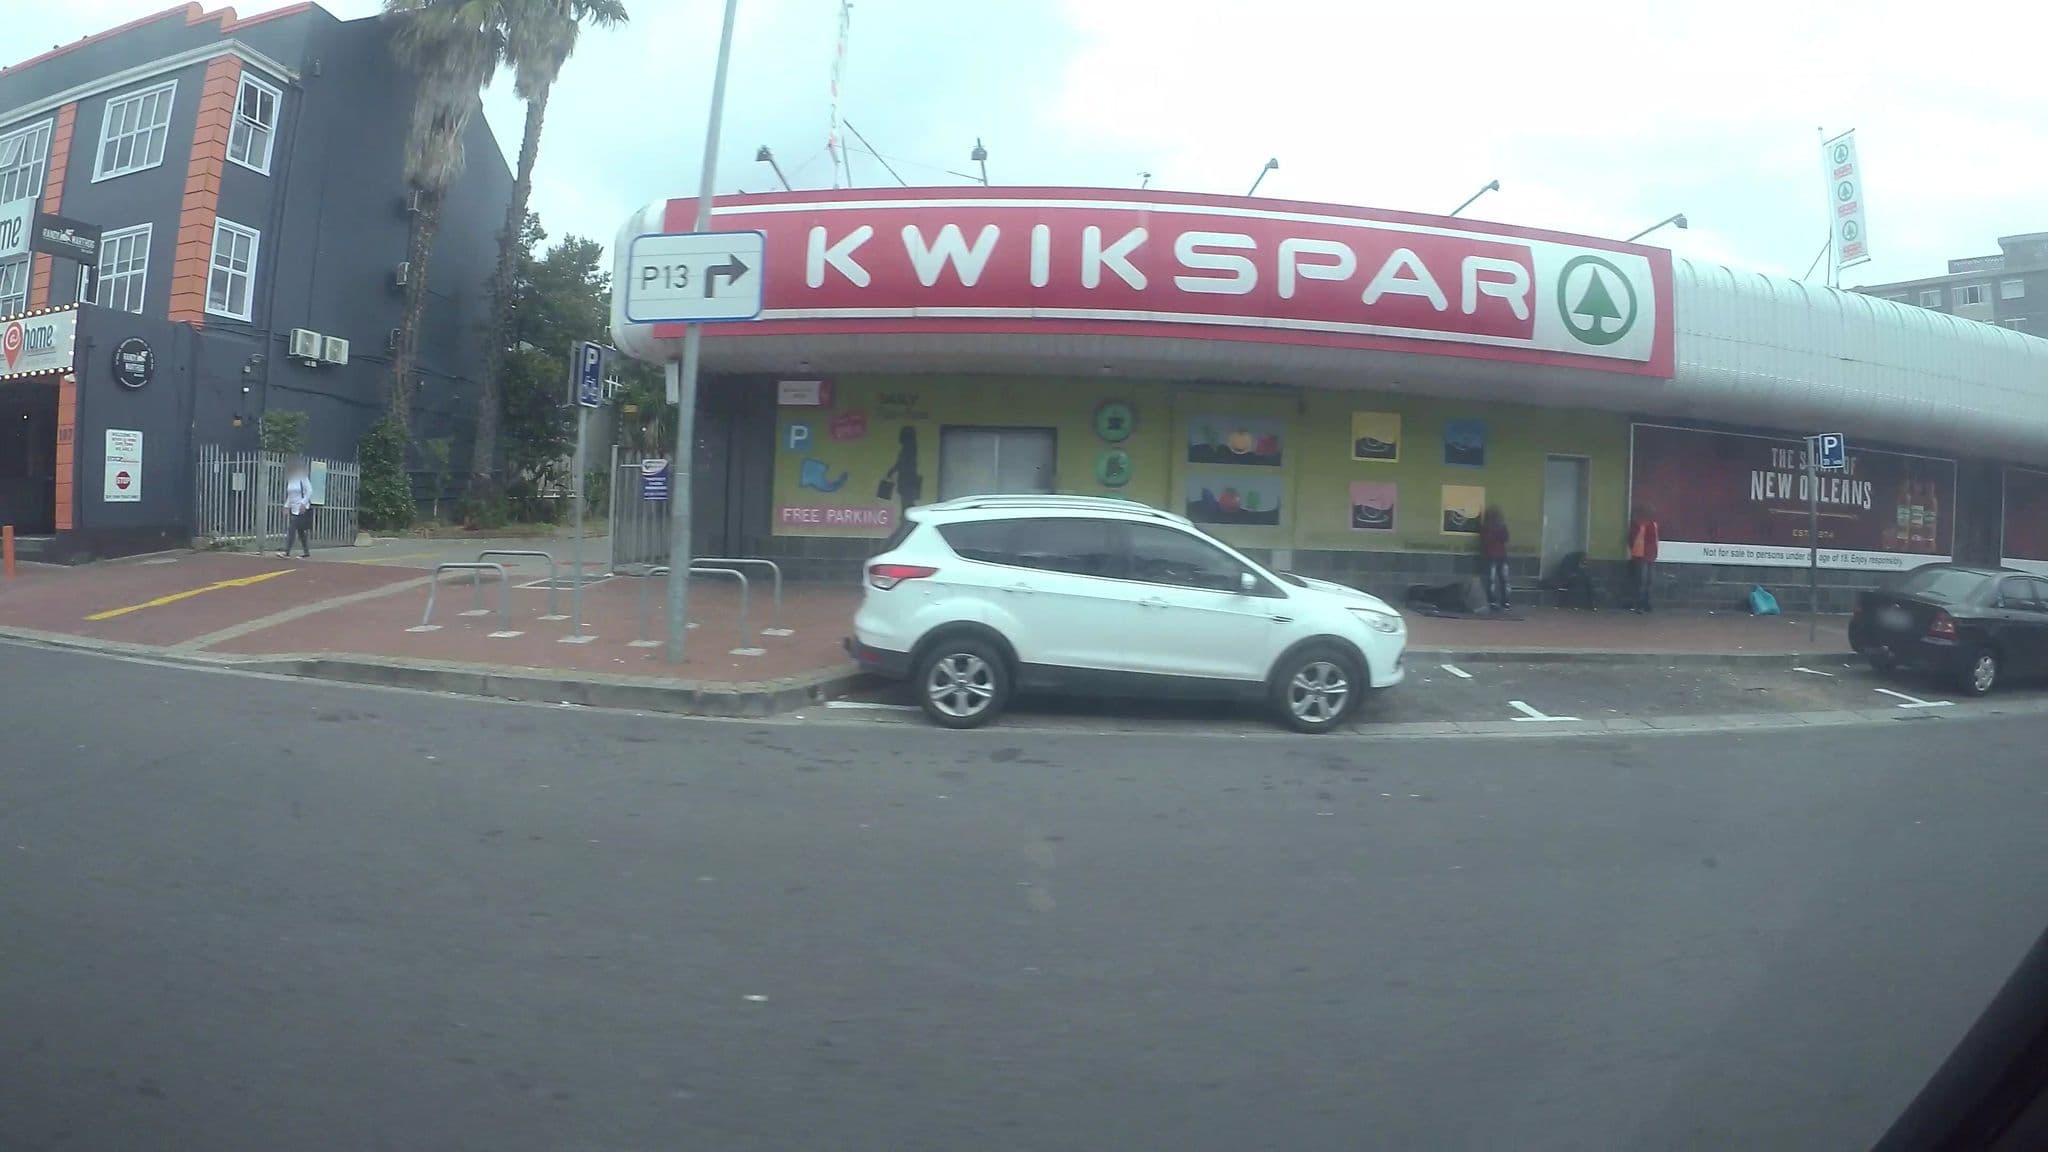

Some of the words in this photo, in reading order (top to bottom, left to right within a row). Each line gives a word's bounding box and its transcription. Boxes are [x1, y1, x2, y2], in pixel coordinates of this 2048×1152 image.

[641, 264, 689, 290] P13
[805, 223, 1531, 320] KWIKSPAR
[585, 347, 599, 372] P
[790, 425, 808, 449] P
[1824, 436, 1838, 455] P
[1772, 448, 1794, 469] THE
[1843, 456, 1857, 475] OF
[1751, 470, 1792, 501] NEW
[783, 507, 821, 524] FREE
[826, 508, 889, 526] PARKING
[1703, 548, 1717, 557] Not
[1718, 548, 1729, 557] for
[1730, 549, 1745, 558] sale
[1746, 550, 1755, 558] to
